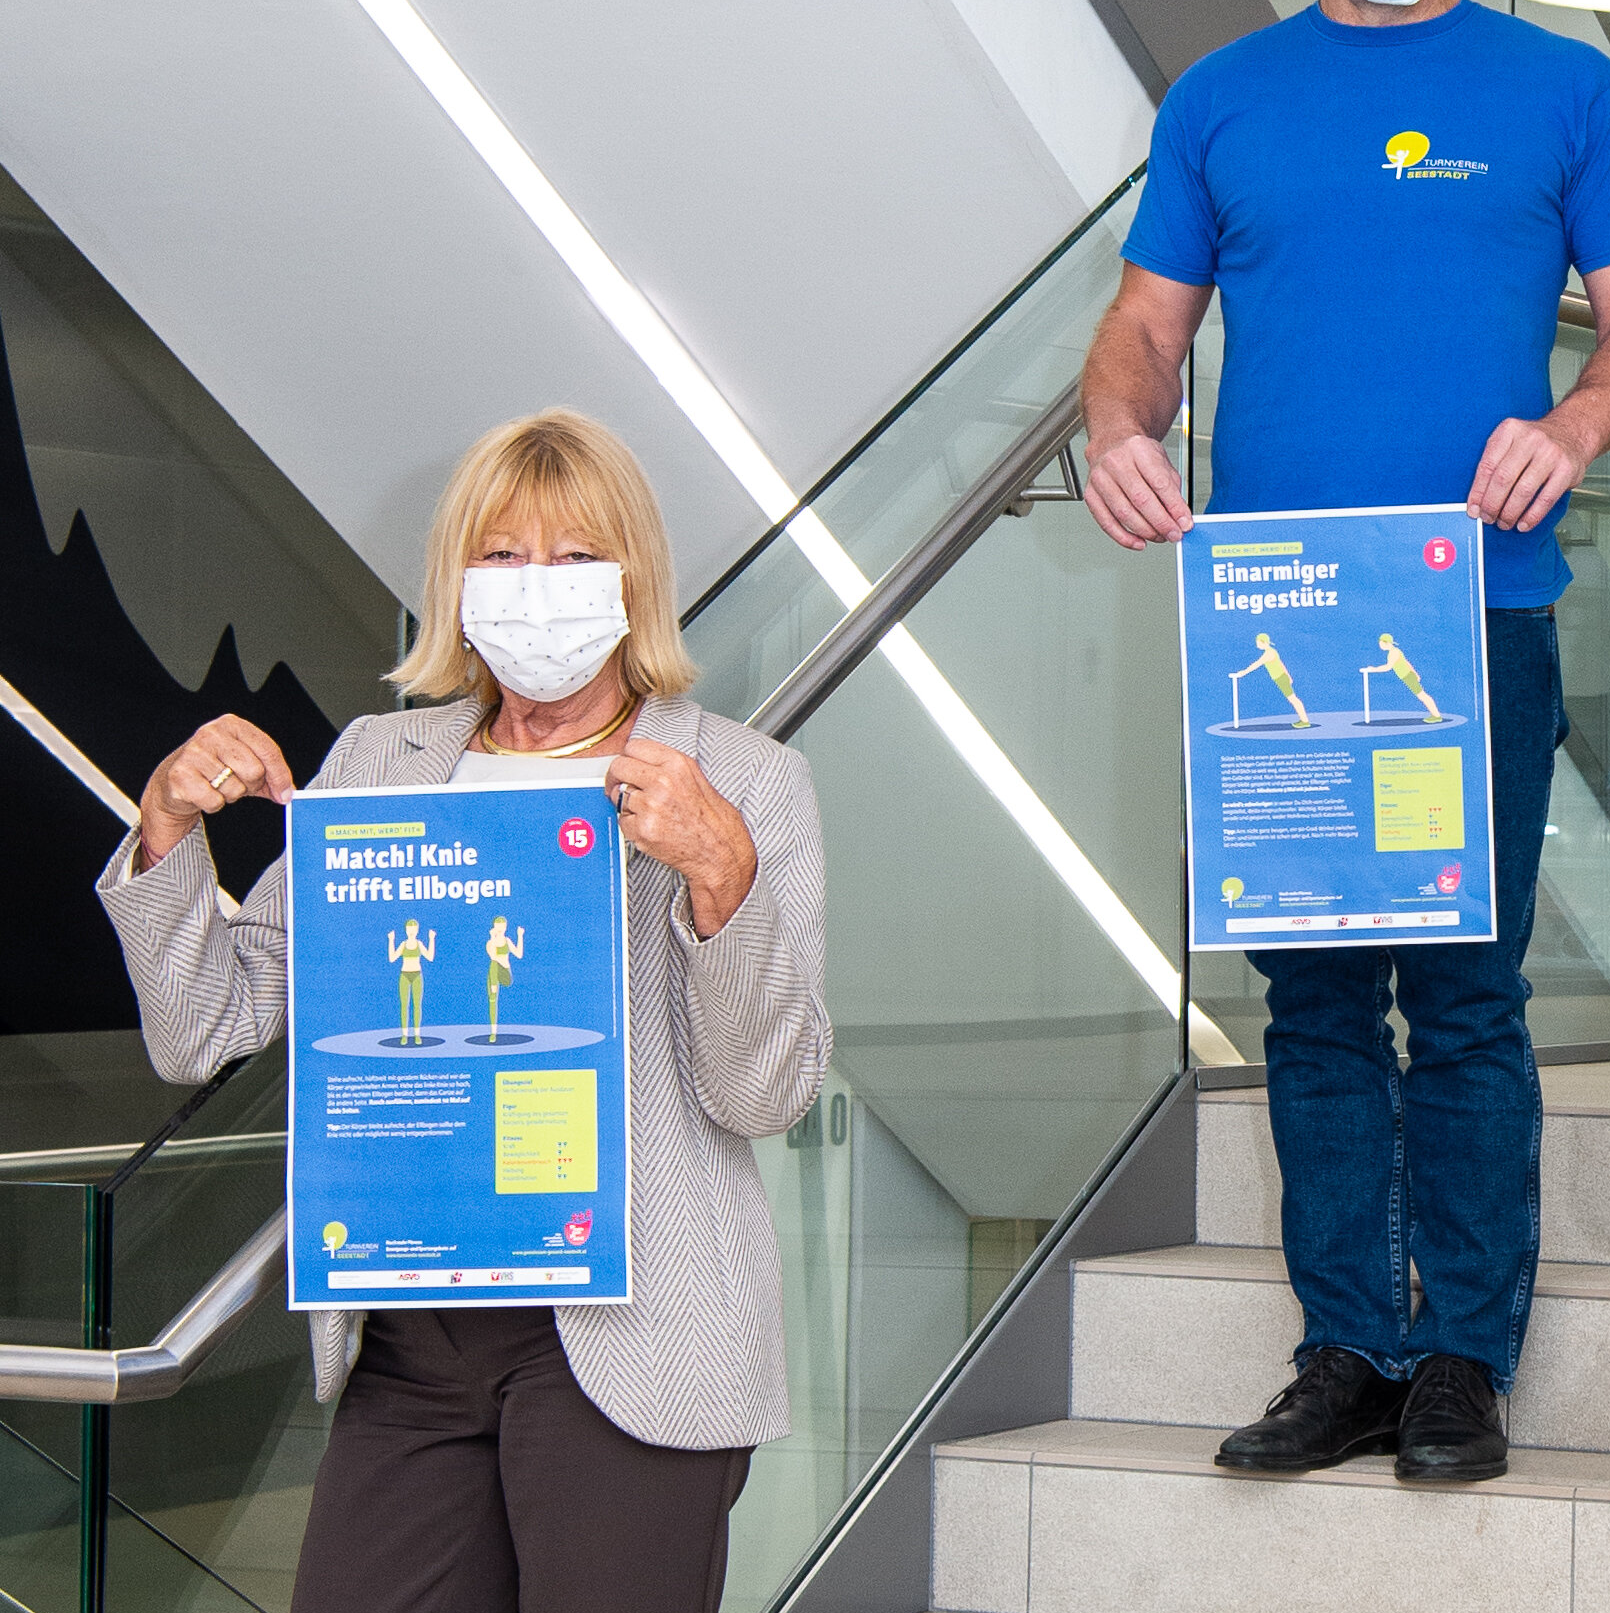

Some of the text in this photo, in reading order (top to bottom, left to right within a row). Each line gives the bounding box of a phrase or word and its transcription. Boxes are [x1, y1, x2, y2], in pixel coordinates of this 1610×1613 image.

[1407, 170, 1470, 180] SEESTADT
[1424, 158, 1488, 171] TURNVEREIN
[1433, 547, 1446, 563] 5
[1213, 559, 1339, 585] Einarmiger
[1214, 586, 1338, 615] Liegestütz
[565, 829, 588, 848] 15
[325, 841, 478, 870] Match! Knie
[325, 875, 511, 905] trifft Ellbogen
